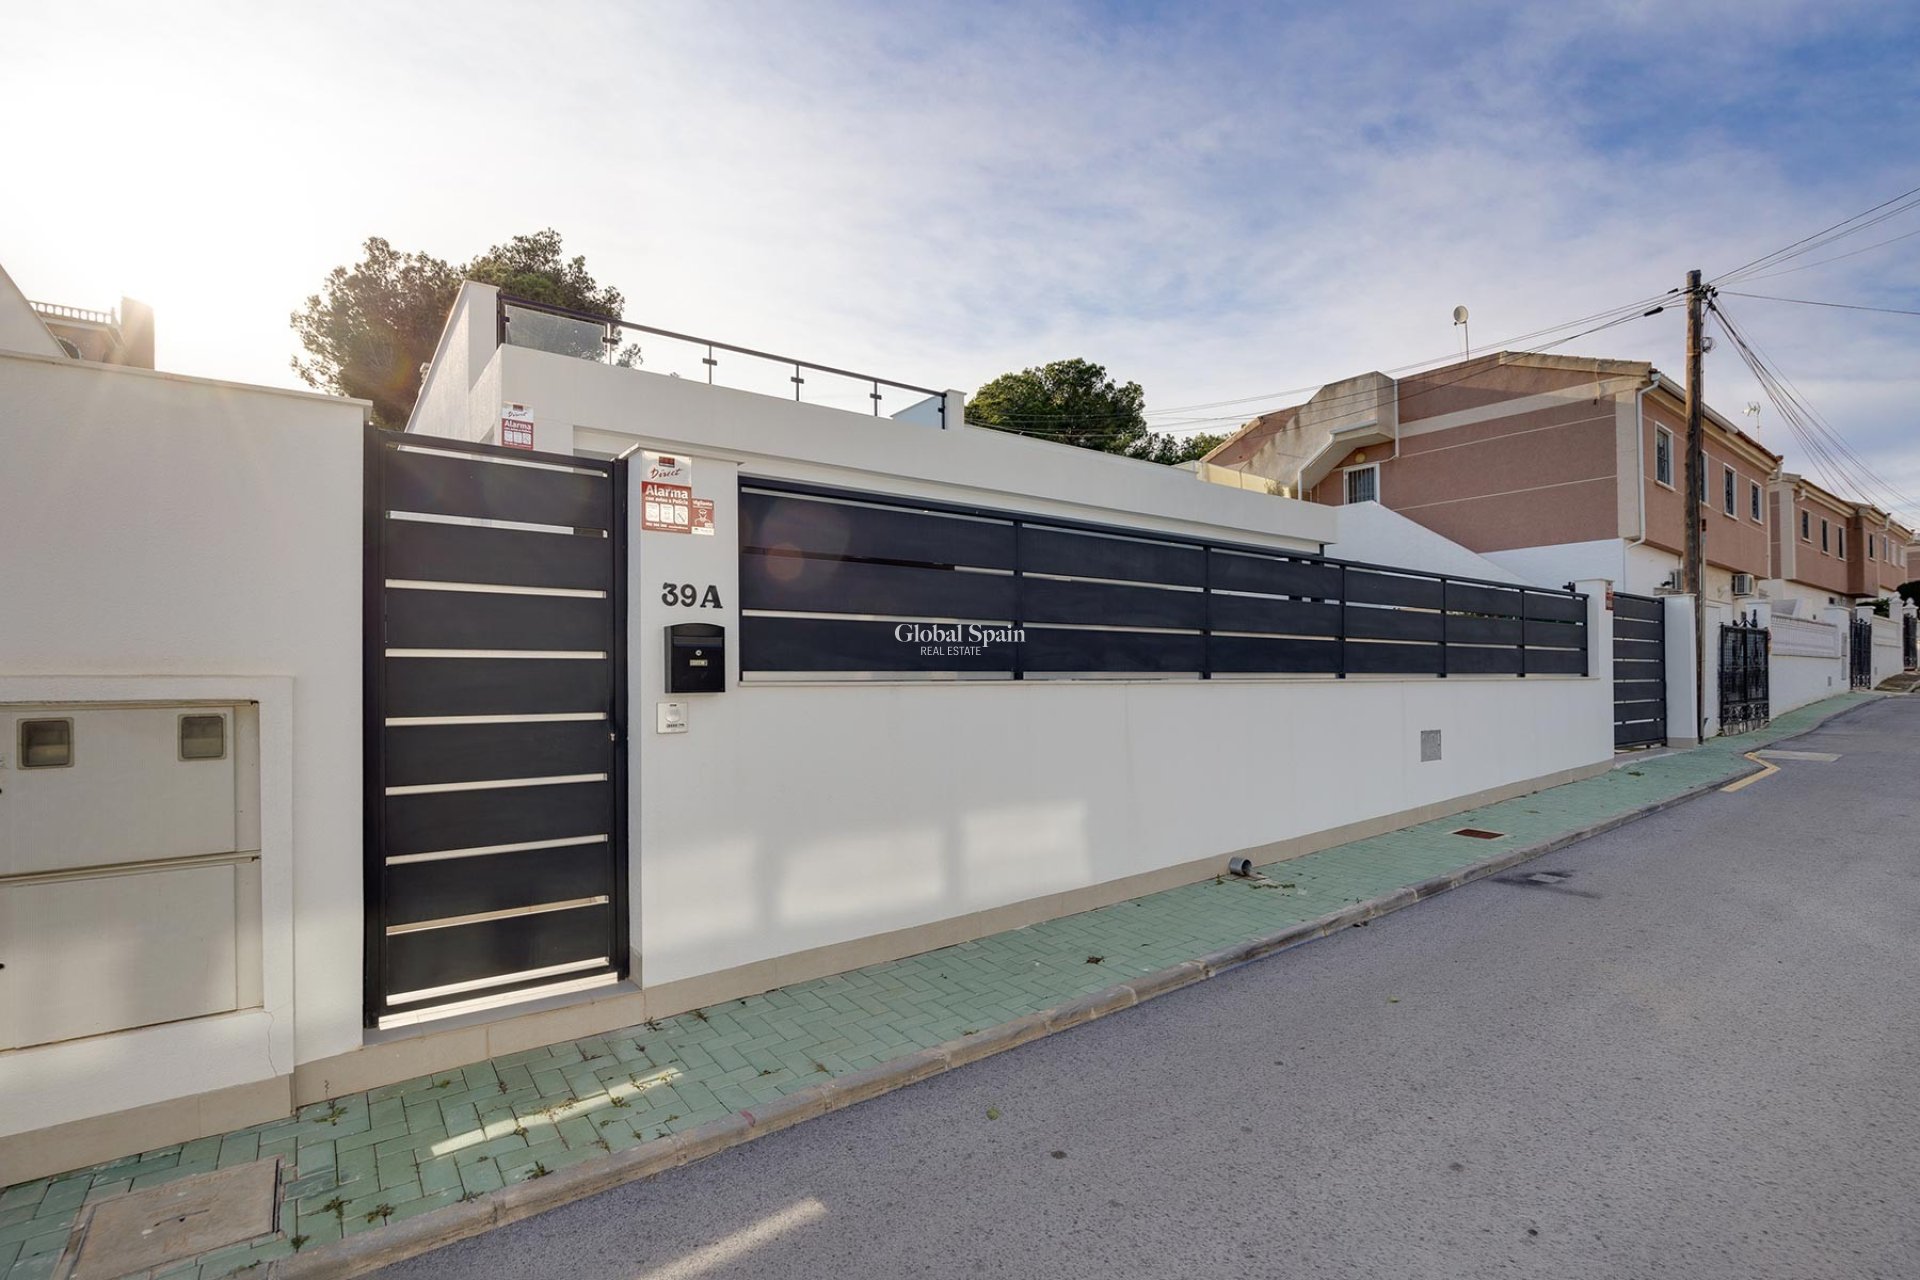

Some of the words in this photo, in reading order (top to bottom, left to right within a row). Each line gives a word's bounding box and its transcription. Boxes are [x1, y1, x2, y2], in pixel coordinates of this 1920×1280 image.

[504, 419, 532, 430] Alarma
[651, 467, 683, 479] Direct
[645, 485, 689, 499] Alarma
[661, 582, 723, 609] 39A
